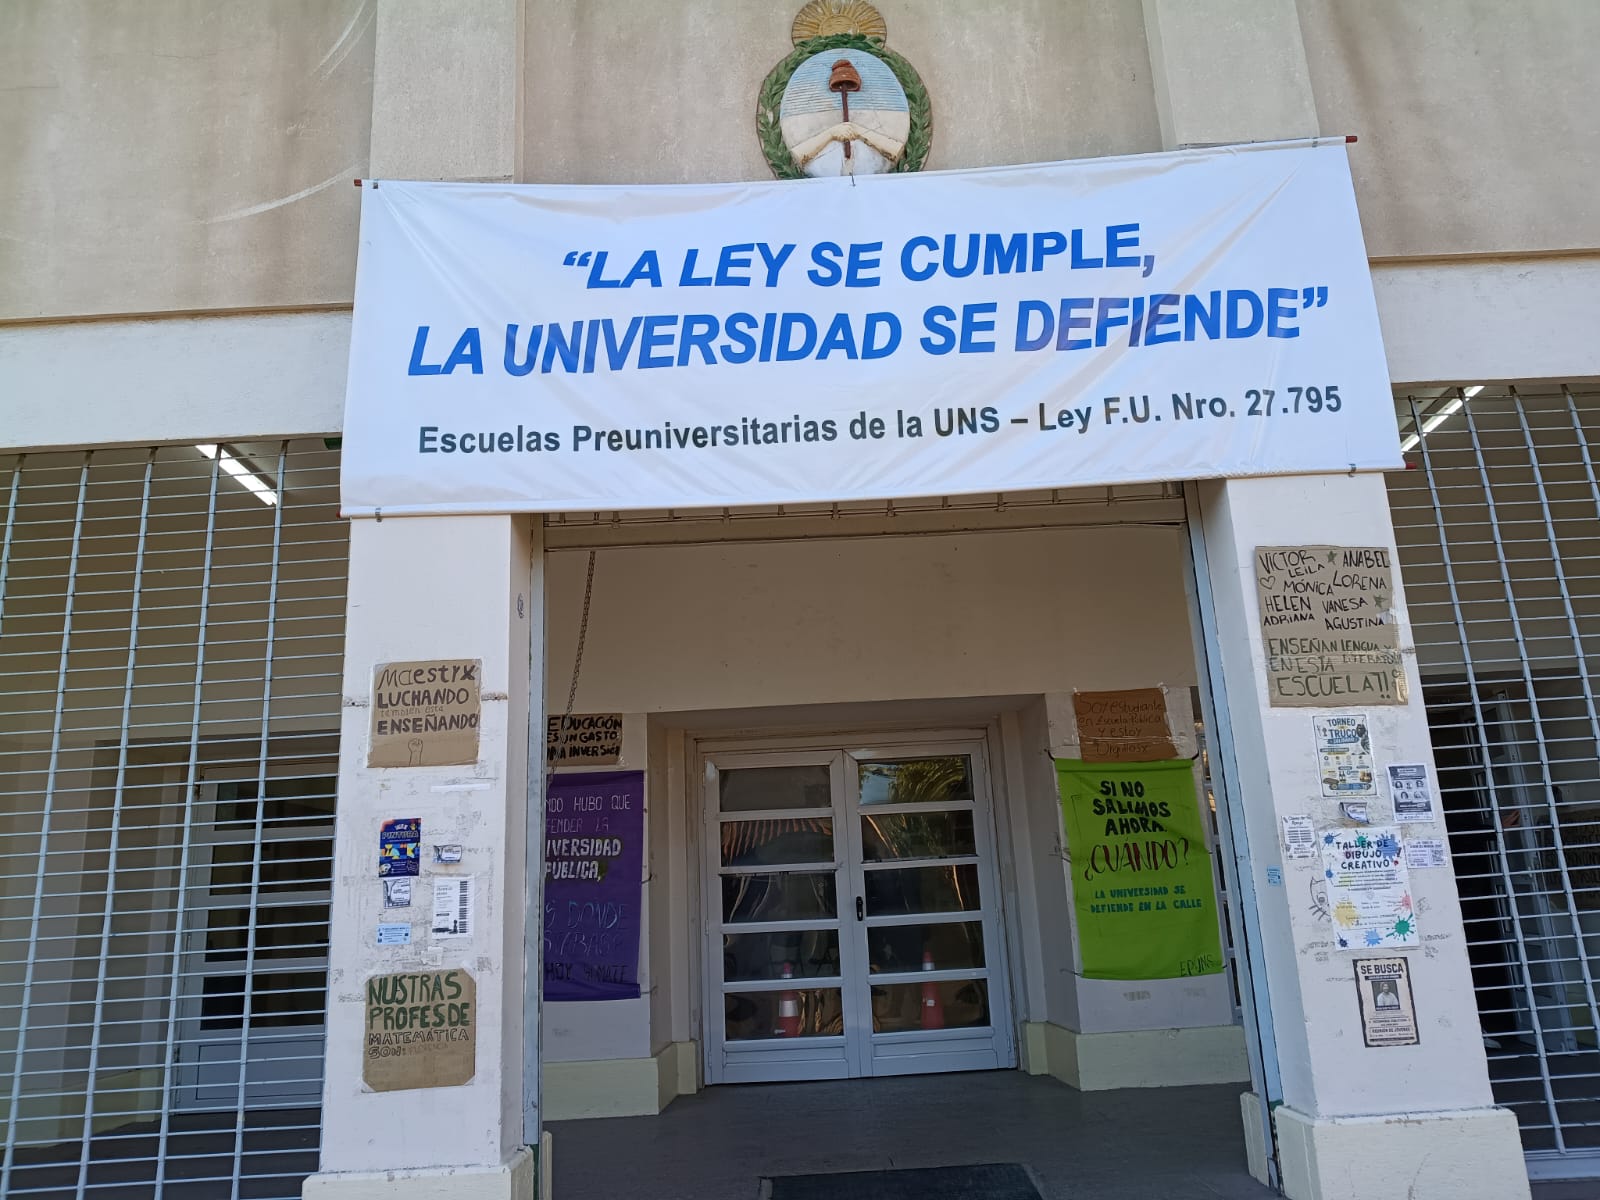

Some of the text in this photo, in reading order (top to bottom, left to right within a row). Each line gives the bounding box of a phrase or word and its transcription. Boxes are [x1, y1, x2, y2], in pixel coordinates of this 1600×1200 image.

[562, 223, 1155, 289] “LA LEY SE CUMPLE,
[407, 286, 1328, 377] LA UNIVERSIDAD SE DEFIENDE”
[419, 425, 561, 454] Escuelas
[573, 414, 838, 452] Preuniversitarias
[849, 411, 886, 440] de
[897, 409, 923, 438] la
[934, 406, 999, 436] UNS
[1039, 402, 1092, 434] Ley
[1105, 396, 1161, 426] F.U.
[1174, 392, 1235, 421] Nro.
[1246, 386, 1343, 417] 27.795
[1342, 550, 1390, 569] ANABEL
[1332, 570, 1387, 591] LORENA
[1265, 595, 1368, 614] HELEN VANESA
[1324, 617, 1385, 631] AGUSTINA
[1268, 637, 1337, 656] ENSEÑAN
[1341, 639, 1380, 652] LENGUA
[378, 688, 469, 709] LUCHANDO
[377, 713, 480, 735] ENSEÑANDO
[1326, 718, 1356, 728] TORNEO
[579, 731, 618, 743] GASTO
[1328, 728, 1357, 739] TRUCO
[1100, 780, 1144, 799] SI NO
[574, 796, 603, 812] HUBO
[611, 794, 632, 811] QUE
[1092, 798, 1172, 818] SALIMOS
[1336, 839, 1389, 850] TALLER DE
[1345, 850, 1382, 860] DIBUJO
[1341, 859, 1390, 871] CREATIVO
[1095, 884, 1187, 900] LA UNIVERSIDAD SE
[1090, 898, 1203, 914] DEFIENDE EN LA CALLE
[1361, 962, 1404, 975] SE BUSCA
